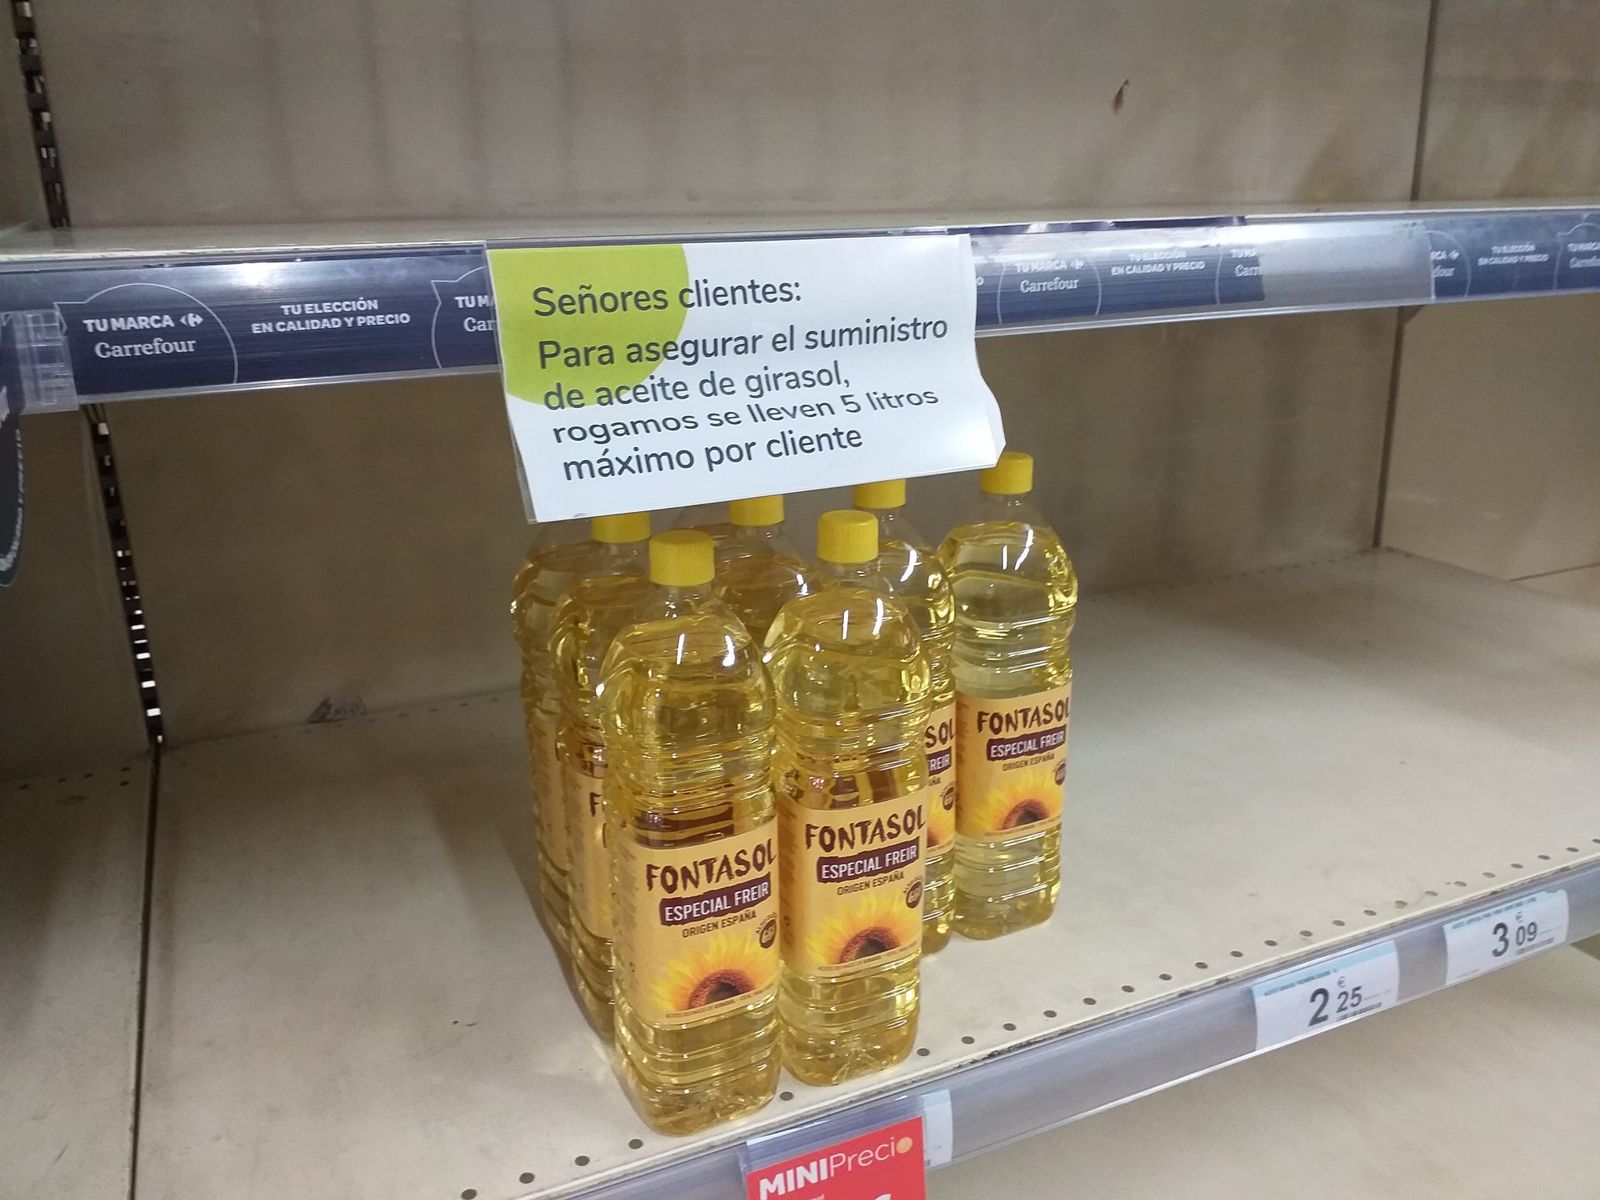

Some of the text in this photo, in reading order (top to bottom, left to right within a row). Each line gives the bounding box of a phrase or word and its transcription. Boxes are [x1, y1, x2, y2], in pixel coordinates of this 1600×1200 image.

[1014, 260, 1068, 272] TU MARCA
[454, 296, 476, 308] TU
[533, 278, 801, 316] Señores clientes:
[1020, 276, 1080, 293] Carrefour
[84, 315, 175, 332] TU MARCA
[252, 314, 410, 334] EN CALIDAD Y PRECIO
[280, 297, 378, 316] TU ELECCIÓN
[94, 338, 196, 358] Carrefour
[538, 316, 948, 369] Para asegurar el suministro
[544, 360, 850, 410] de aceite de girasol,
[553, 391, 939, 444] rogamos se lleven 5 litros
[564, 428, 863, 480] máximo por cliente
[977, 697, 1069, 736] FONTASOL
[990, 739, 1038, 758] ESPECIAL
[805, 805, 926, 852] FONTASOL
[646, 838, 776, 894] FONTASOL
[821, 845, 917, 879] ESPECIAL FREIR
[837, 871, 904, 896] ORIGEN ESPAÑA
[664, 882, 769, 922] ESPECIAL FREIR
[682, 910, 757, 938] ORIGEN ESPAÑA
[1492, 922, 1538, 958] 3 09
[1308, 986, 1362, 1026] 2 25
